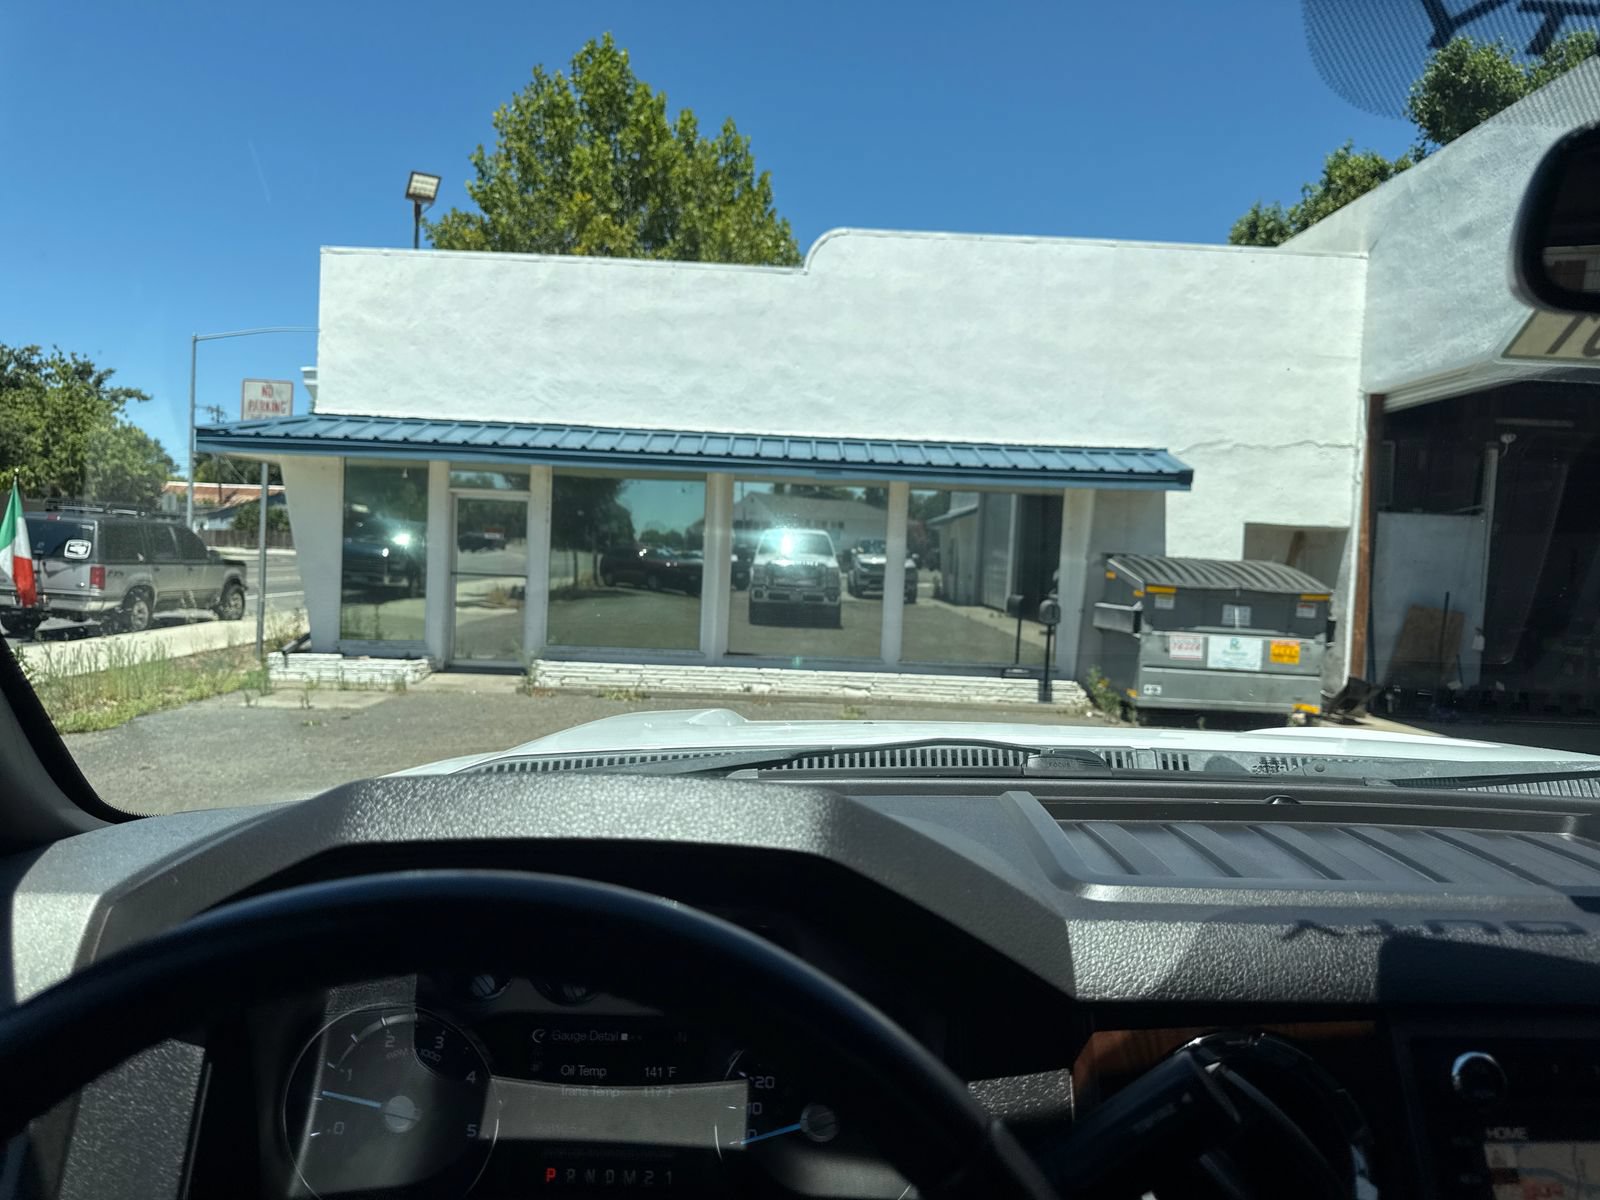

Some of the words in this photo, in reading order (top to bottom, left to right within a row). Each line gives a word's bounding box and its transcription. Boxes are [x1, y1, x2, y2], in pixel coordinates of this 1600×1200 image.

[261, 384, 274, 398] NO
[247, 399, 288, 414] PARKING
[384, 1035, 396, 1048] 2
[434, 1035, 444, 1049] 3
[551, 1030, 587, 1044] Gauge
[590, 1030, 618, 1041] Detail
[466, 1071, 476, 1083] 4
[560, 1064, 575, 1077] Oil
[577, 1064, 607, 1079] Temp
[644, 1067, 663, 1078] 141
[754, 1076, 775, 1089] 20
[334, 1121, 345, 1134] 0
[467, 1124, 477, 1137] 5
[1486, 1127, 1528, 1139] HOME
[545, 1168, 556, 1182] P
[566, 1168, 576, 1184] R
[585, 1168, 596, 1184] N
[605, 1169, 615, 1184] D
[624, 1169, 637, 1184] M
[644, 1170, 654, 1184] 2
[665, 1170, 672, 1184] 1
